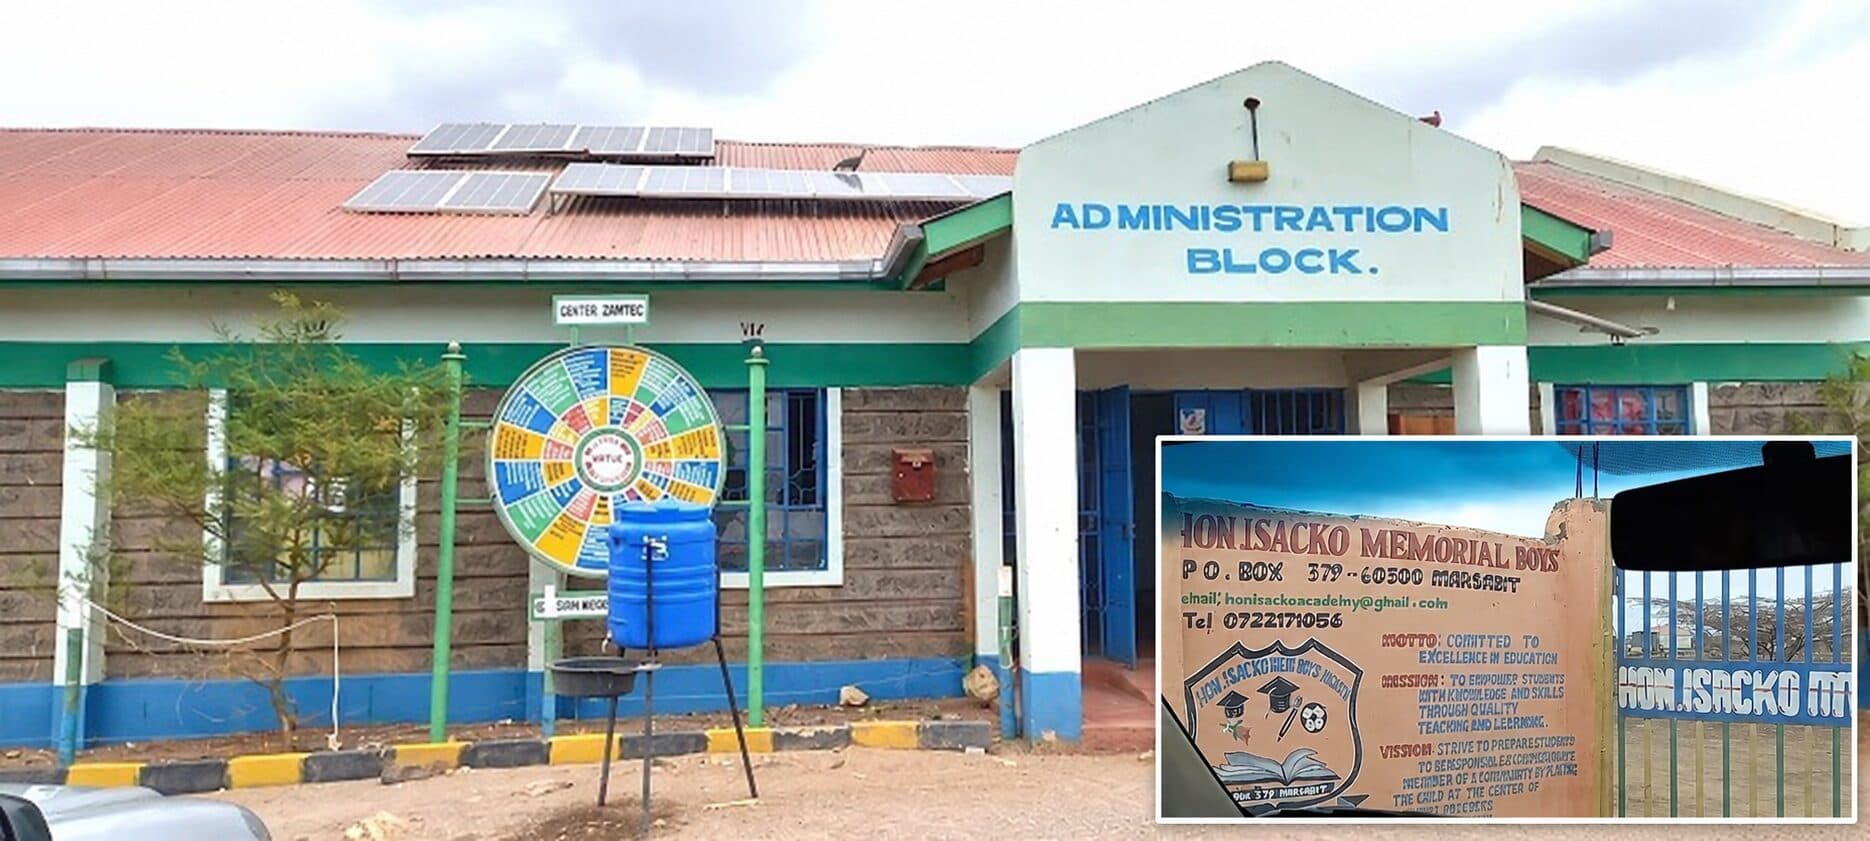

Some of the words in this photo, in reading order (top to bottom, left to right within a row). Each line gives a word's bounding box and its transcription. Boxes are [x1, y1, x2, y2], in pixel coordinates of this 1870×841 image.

[1050, 203, 1449, 233] ADMINISTRATION
[1186, 247, 1379, 275] BLOCK.
[560, 304, 598, 317] CENTER
[1360, 527, 1510, 570] MEMORIAL
[1515, 545, 1561, 573] BOYS
[1239, 561, 1284, 582] BOX
[1431, 569, 1520, 593] MARSABIT
[1223, 612, 1343, 629] 0722171056
[1523, 635, 1540, 649] TO
[1418, 649, 1488, 664] EXCELLENCE
[1490, 652, 1500, 665] IN
[1504, 652, 1558, 665] EDUCATION
[1450, 674, 1466, 687] TO
[1522, 673, 1565, 685] STUDENTS
[1447, 688, 1507, 701] KNOWLEDGE
[1511, 687, 1530, 699] AND
[1532, 686, 1564, 699] SKILLS
[1419, 703, 1468, 719] THROUGH
[1471, 702, 1519, 716] QUALITY
[1471, 718, 1491, 731] AND
[1437, 741, 1474, 756] STRIVE
[1477, 740, 1490, 752] TO
[1491, 737, 1534, 751] PREPARE
[1418, 761, 1433, 773] TO
[1455, 773, 1469, 785] OF
[1393, 793, 1414, 807] THE
[1416, 790, 1444, 804] CHILD
[1448, 788, 1461, 801] AT
[1467, 786, 1485, 799] THE
[1488, 782, 1524, 797] CENTER
[1528, 781, 1540, 793] OF
